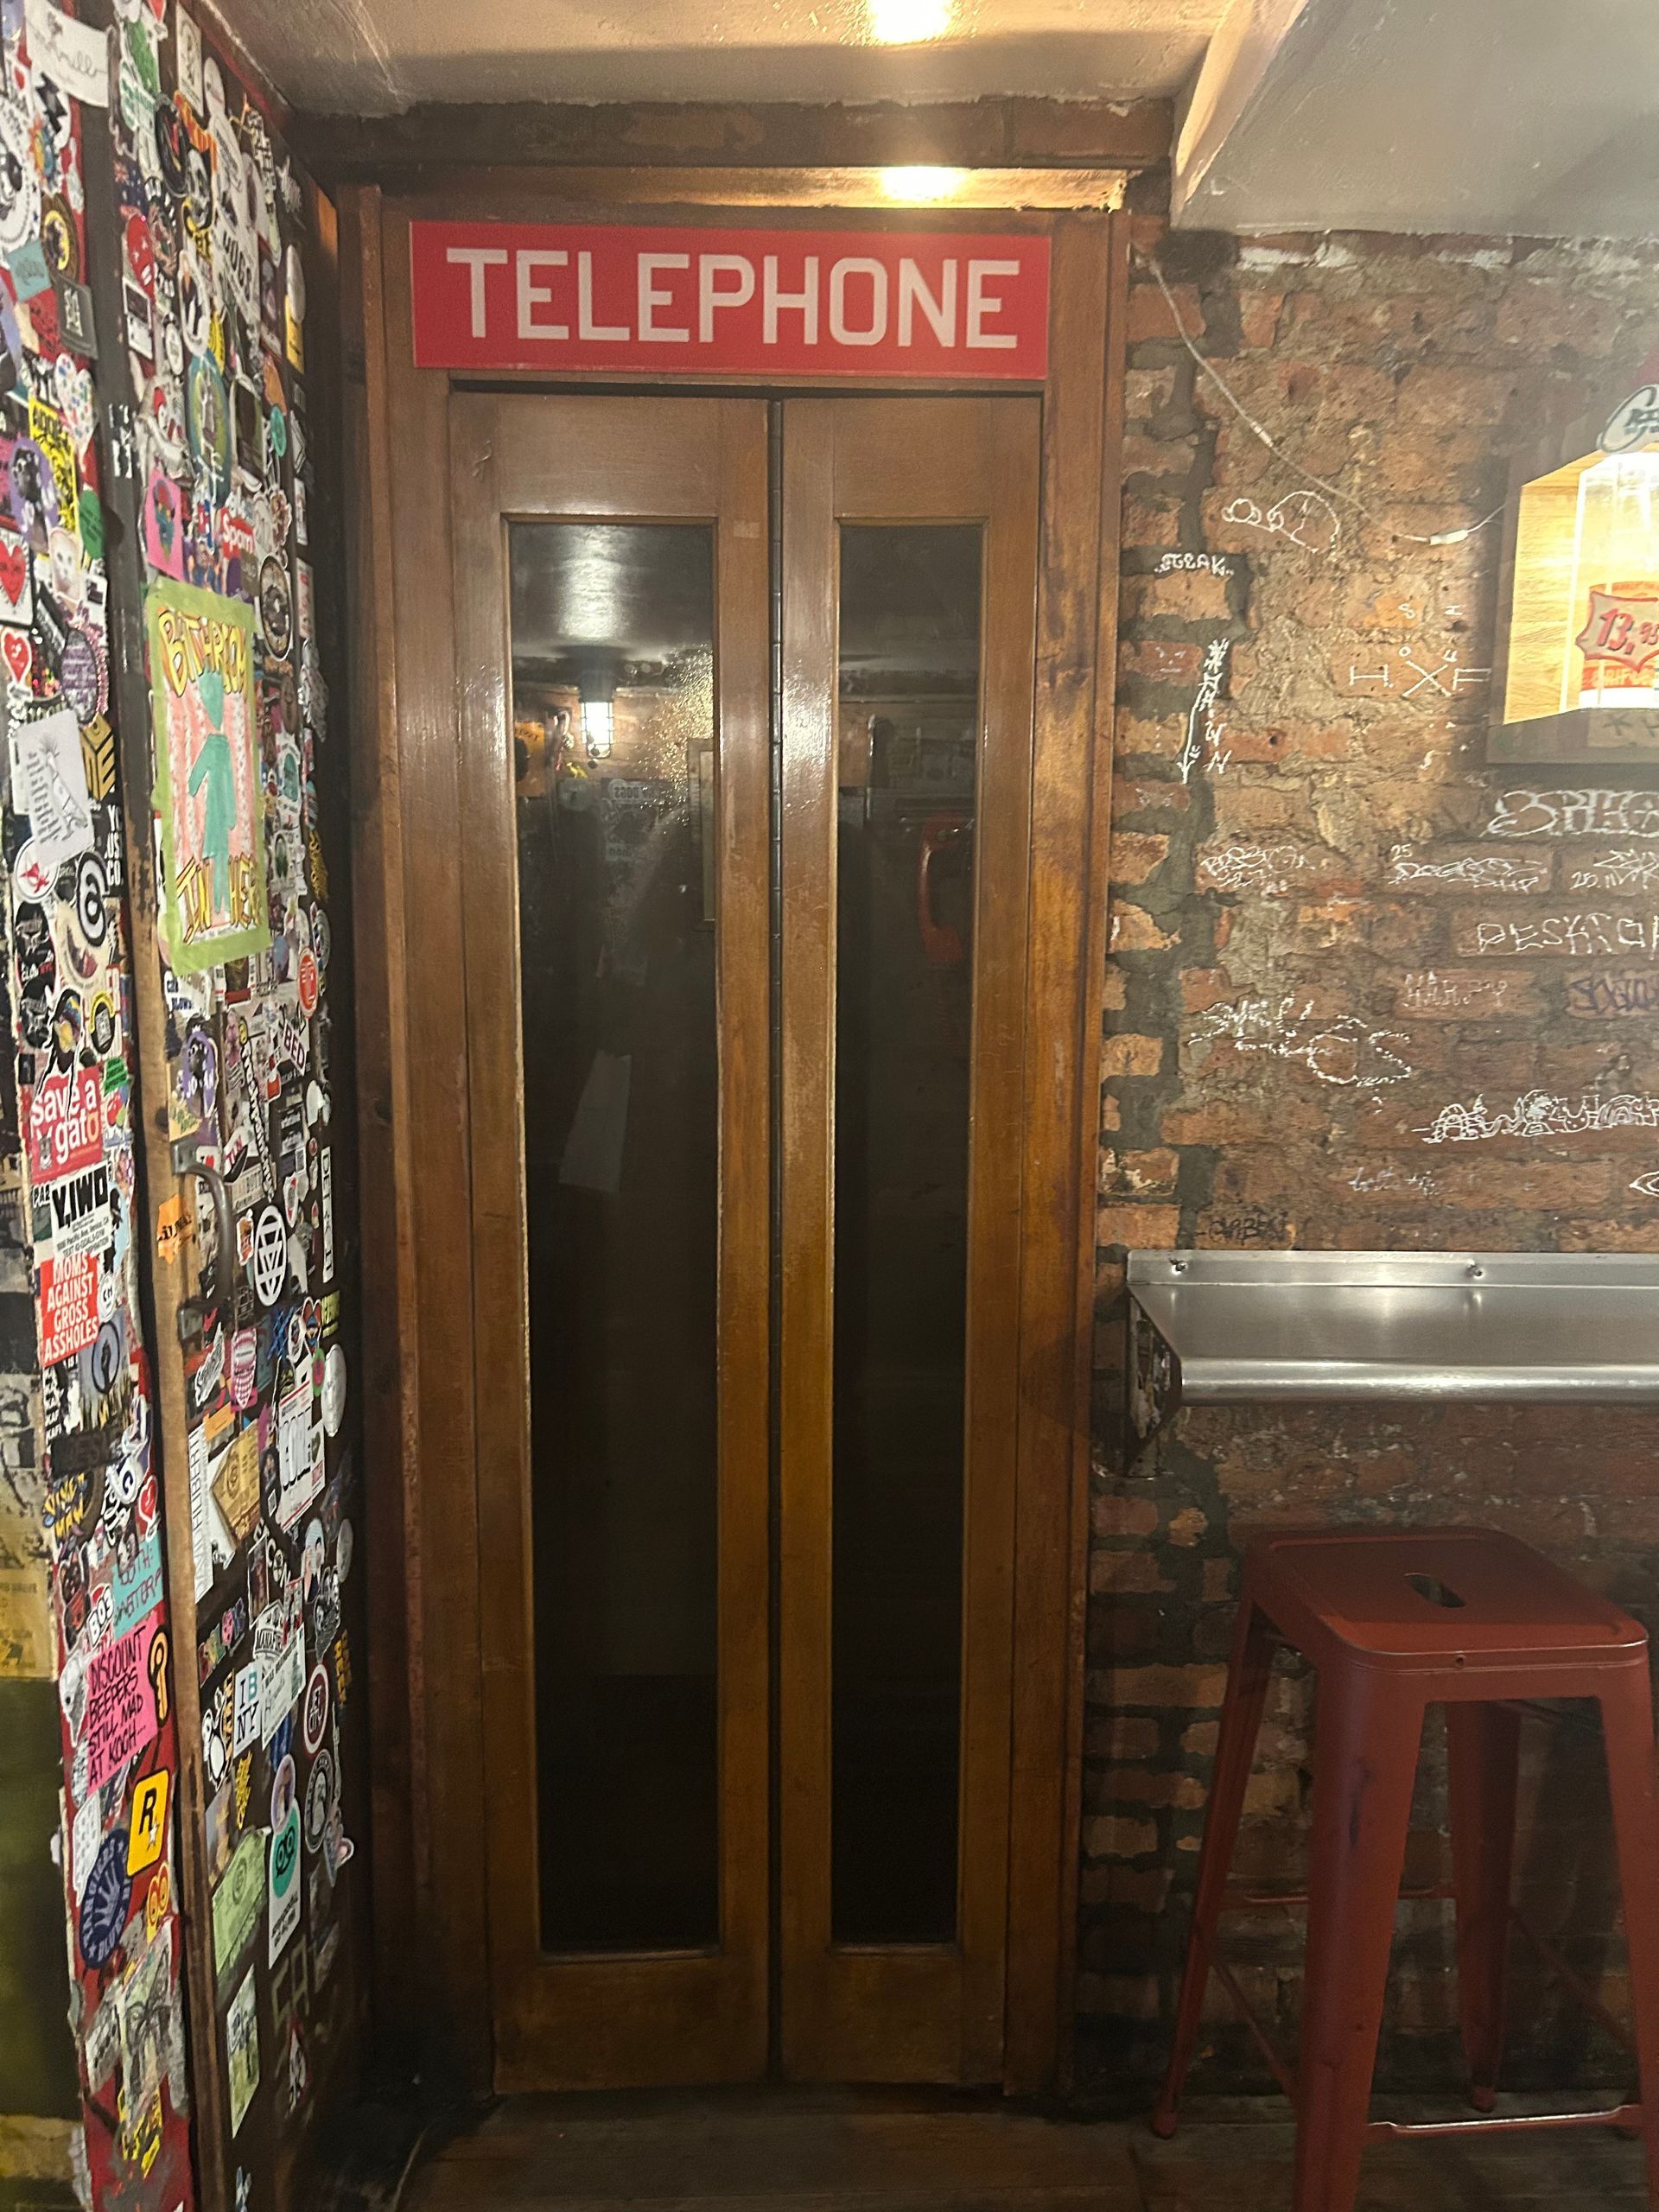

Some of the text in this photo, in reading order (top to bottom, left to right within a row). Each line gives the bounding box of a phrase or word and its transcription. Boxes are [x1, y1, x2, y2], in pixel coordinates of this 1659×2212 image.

[446, 247, 1020, 350] TELEPHONE
[31, 1079, 97, 1128] save a
[54, 1109, 99, 1165] gato
[47, 1271, 94, 1313] AGAINST
[53, 1250, 89, 1286] MOMS
[54, 1298, 89, 1333] GROSS
[44, 1316, 99, 1365] ASSHOLES
[91, 1625, 147, 1696] DISCOUNT
[89, 1667, 138, 1729] BEEPERS
[87, 1694, 143, 1758] STILL MAD
[236, 1700, 259, 1746] NY
[89, 1750, 105, 1787] AT
[138, 1787, 157, 1835] R
